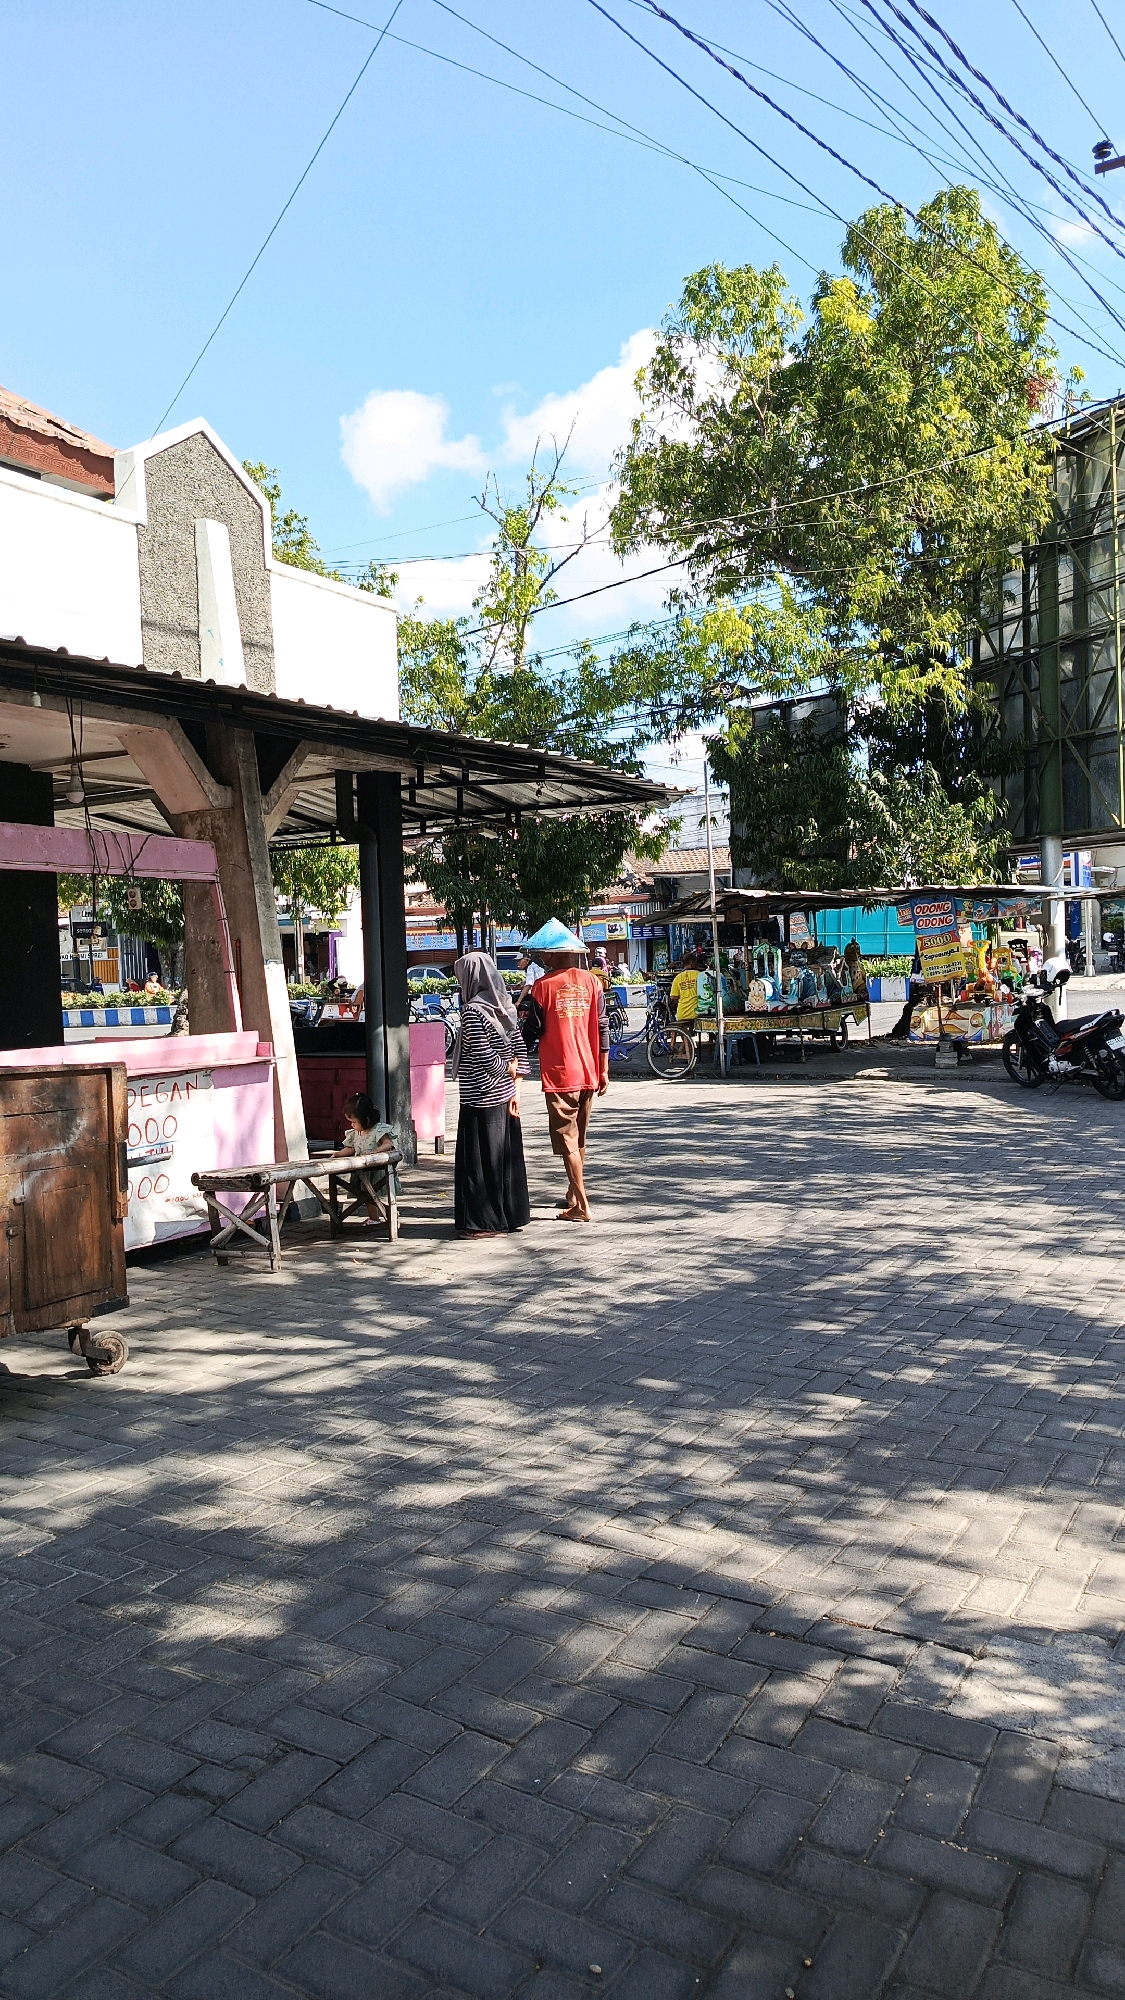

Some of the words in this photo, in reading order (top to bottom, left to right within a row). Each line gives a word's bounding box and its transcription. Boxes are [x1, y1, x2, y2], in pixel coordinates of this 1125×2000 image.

[914, 902, 951, 915] ODONG
[917, 915, 954, 928] ODONG
[924, 934, 952, 948] 5000
